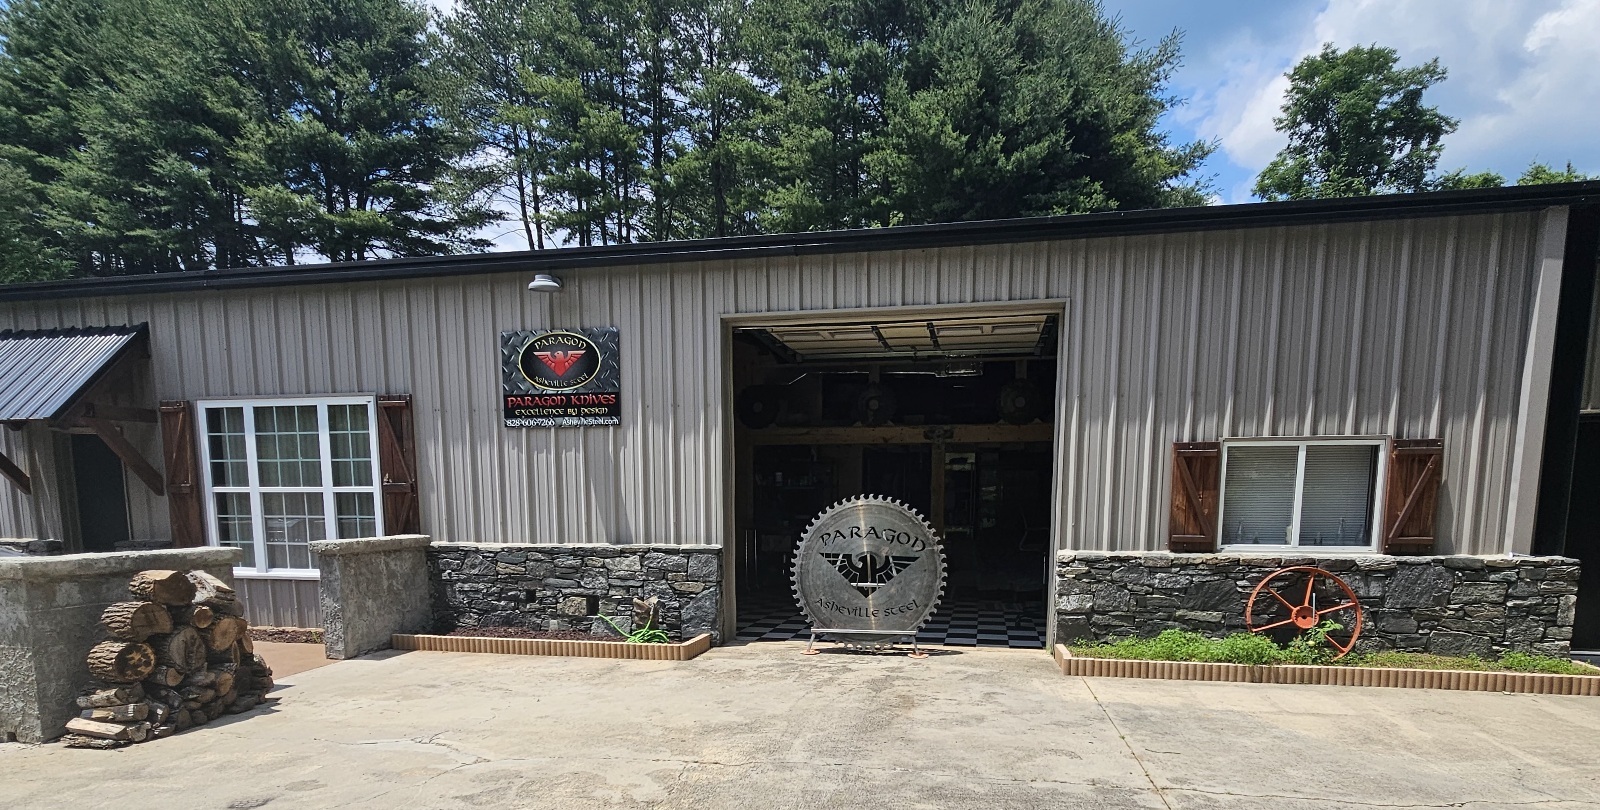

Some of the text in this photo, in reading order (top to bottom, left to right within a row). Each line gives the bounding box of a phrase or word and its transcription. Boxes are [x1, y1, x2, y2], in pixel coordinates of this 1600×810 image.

[534, 336, 587, 350] PARAGON
[507, 394, 616, 408] PARAGON KNIVES
[819, 526, 926, 552] PARAGON
